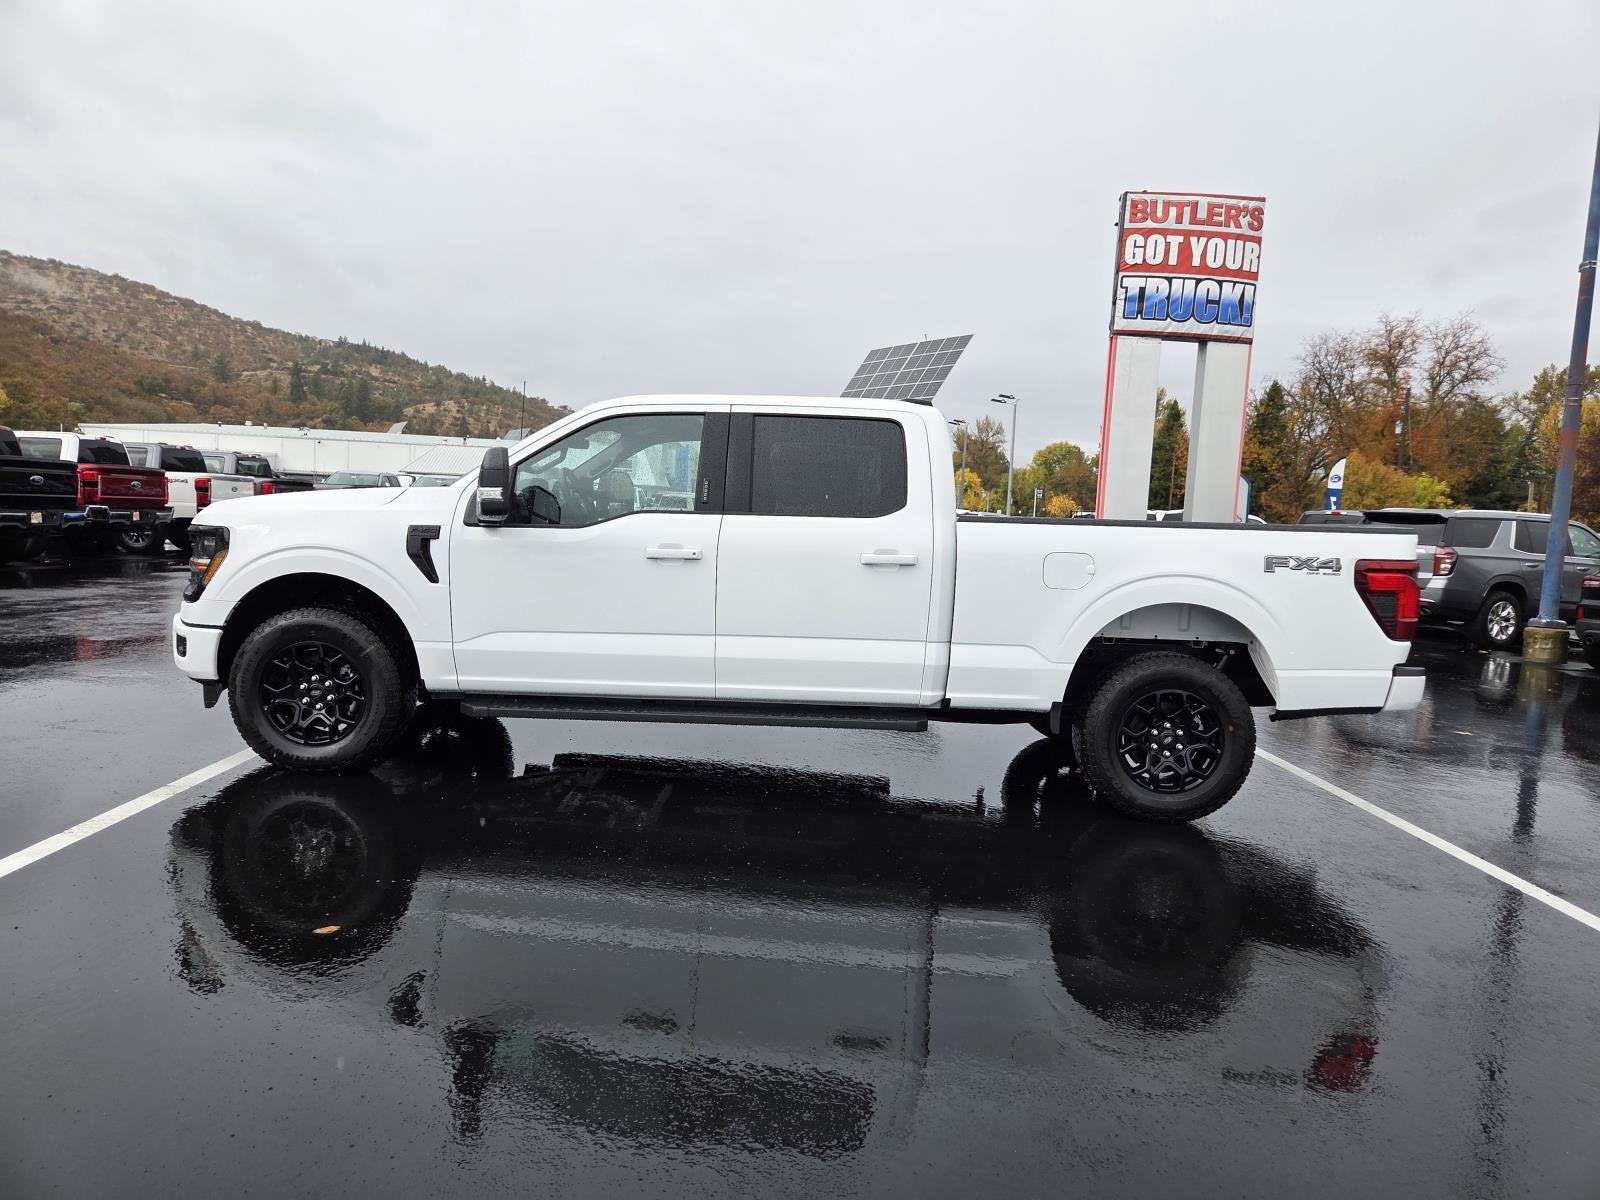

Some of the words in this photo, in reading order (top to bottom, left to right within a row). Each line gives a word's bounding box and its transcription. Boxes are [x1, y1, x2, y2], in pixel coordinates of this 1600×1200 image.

[1128, 198, 1265, 232] BUTLER'S
[1124, 233, 1184, 266] GOT
[1189, 236, 1260, 273] YOUR
[1120, 275, 1256, 327] TRUCK!
[1263, 555, 1342, 573] FX4
